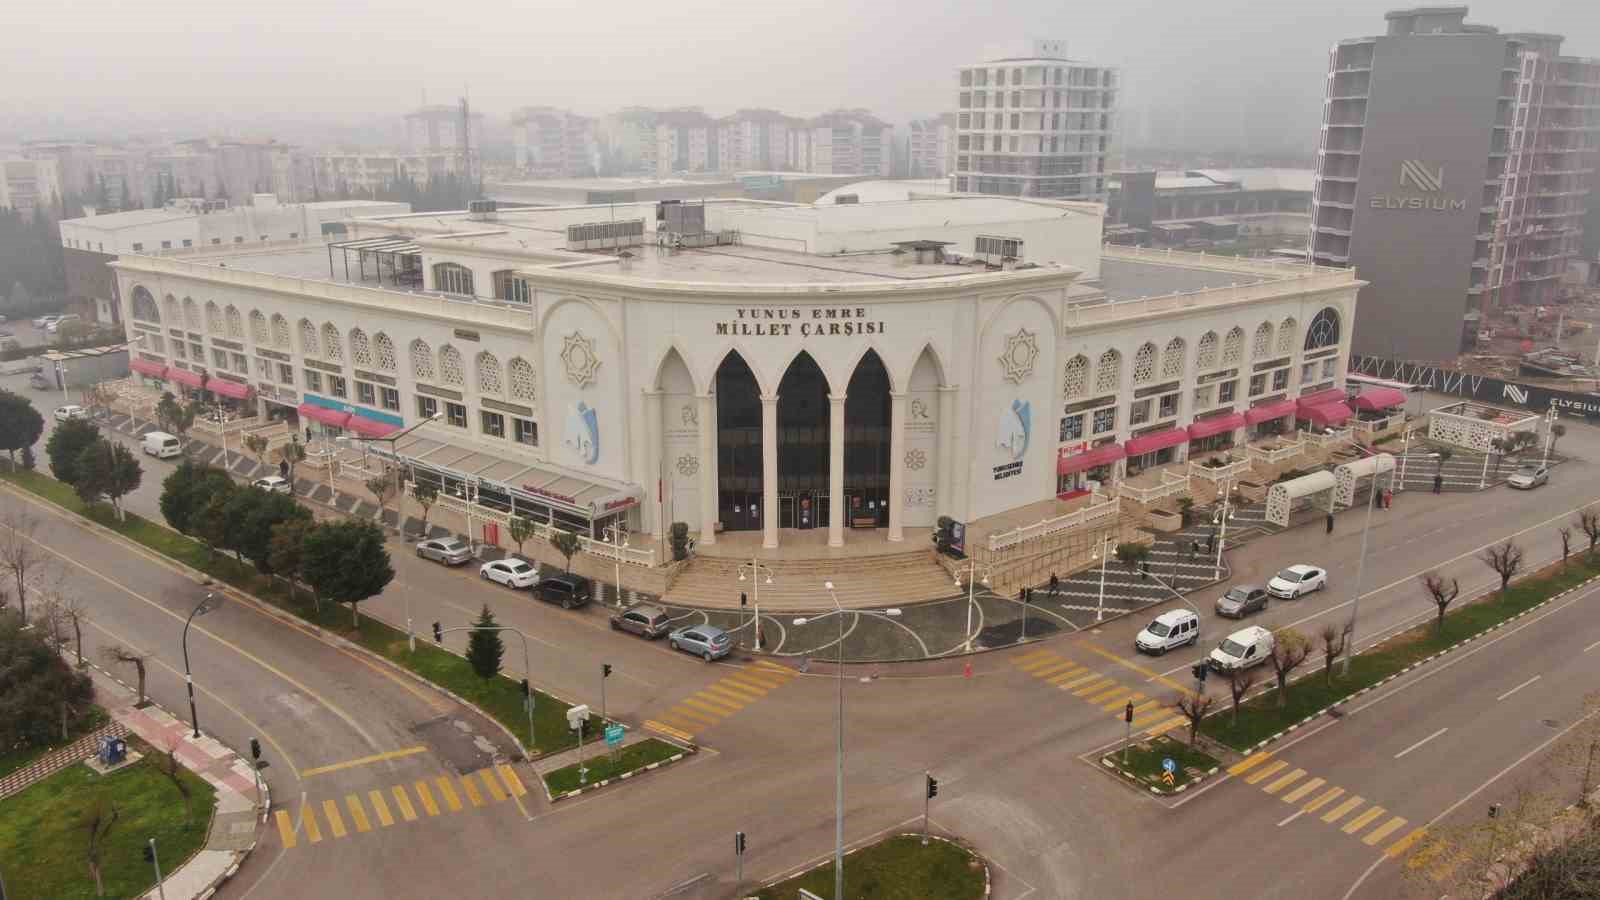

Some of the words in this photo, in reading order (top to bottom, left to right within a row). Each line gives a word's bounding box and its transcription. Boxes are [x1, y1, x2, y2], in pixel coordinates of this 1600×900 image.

[1370, 197, 1466, 210] ELYSIUM
[737, 309, 800, 319] YUNUS
[812, 308, 865, 319] EMRE
[716, 320, 791, 336] MİLLET
[801, 321, 884, 337] ÇARŞISI
